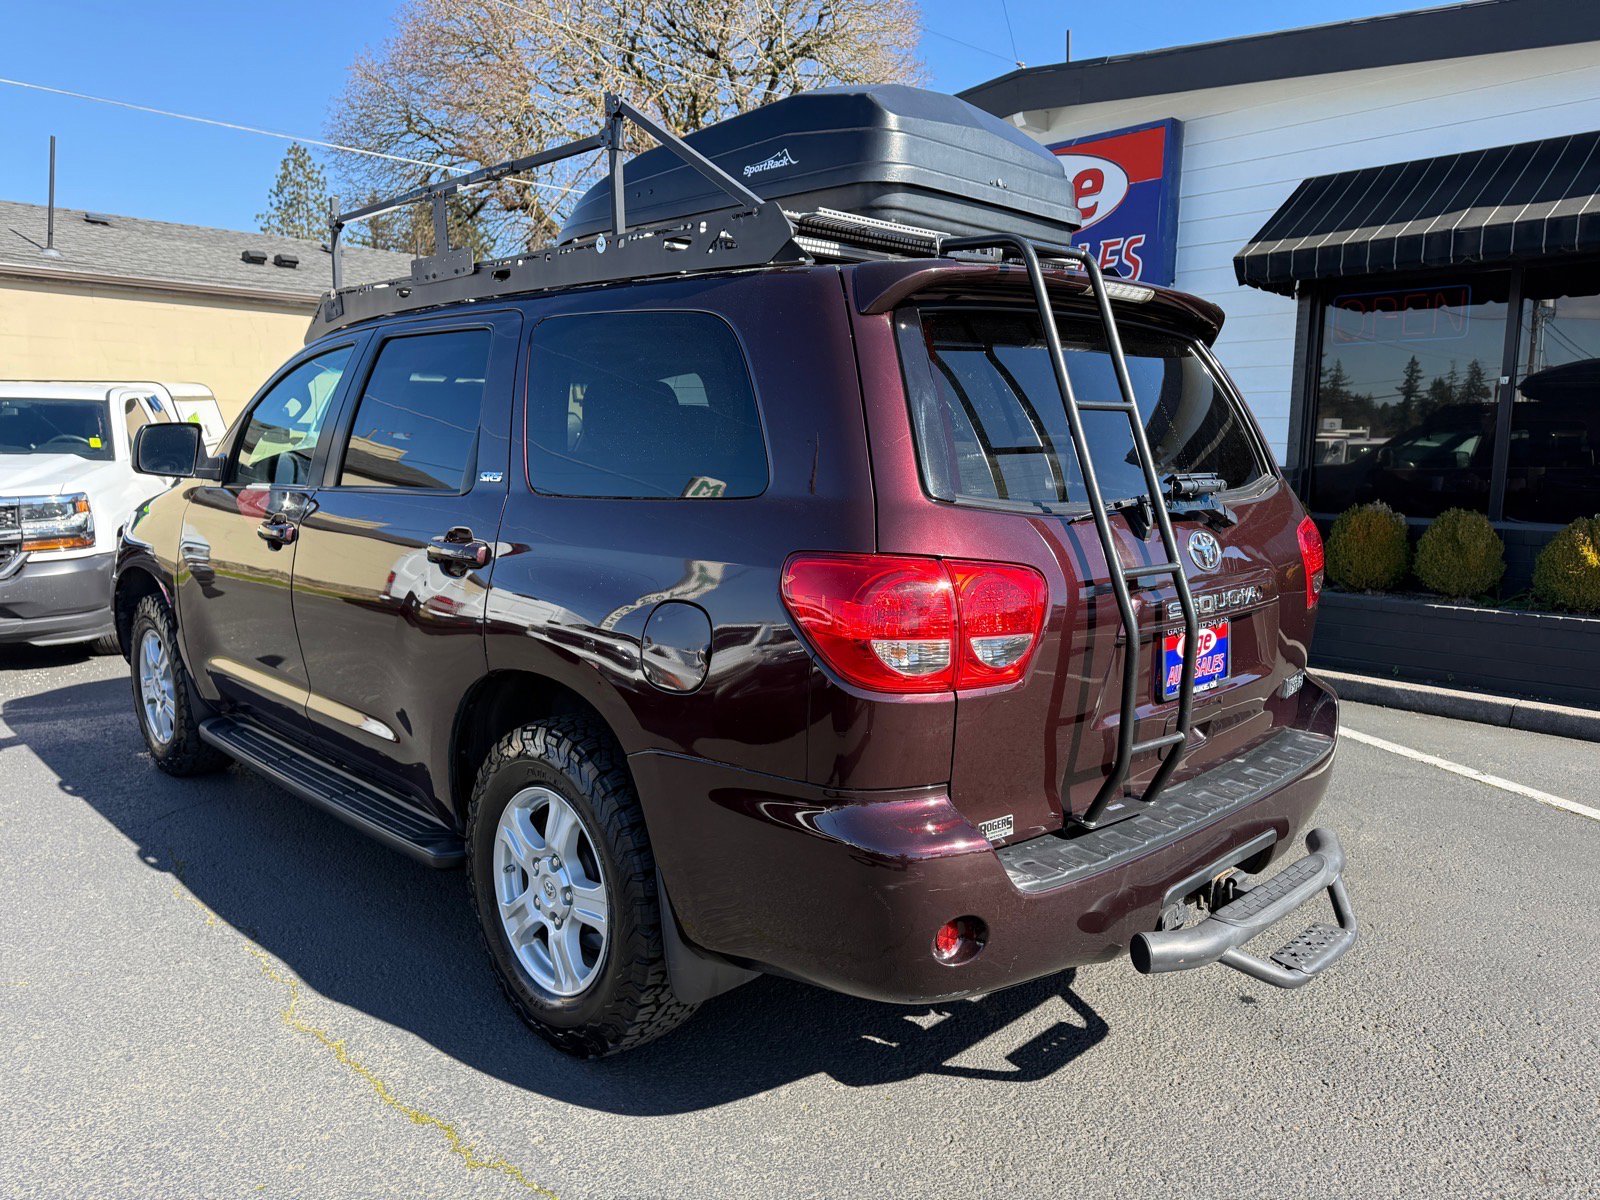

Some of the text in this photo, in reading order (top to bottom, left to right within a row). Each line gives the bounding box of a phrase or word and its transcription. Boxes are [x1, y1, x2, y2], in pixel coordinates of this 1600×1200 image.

[742, 156, 789, 178] SportRack
[1336, 288, 1467, 342] OPEN
[1194, 653, 1225, 679] SALES
[979, 816, 1013, 839] ROGERS
